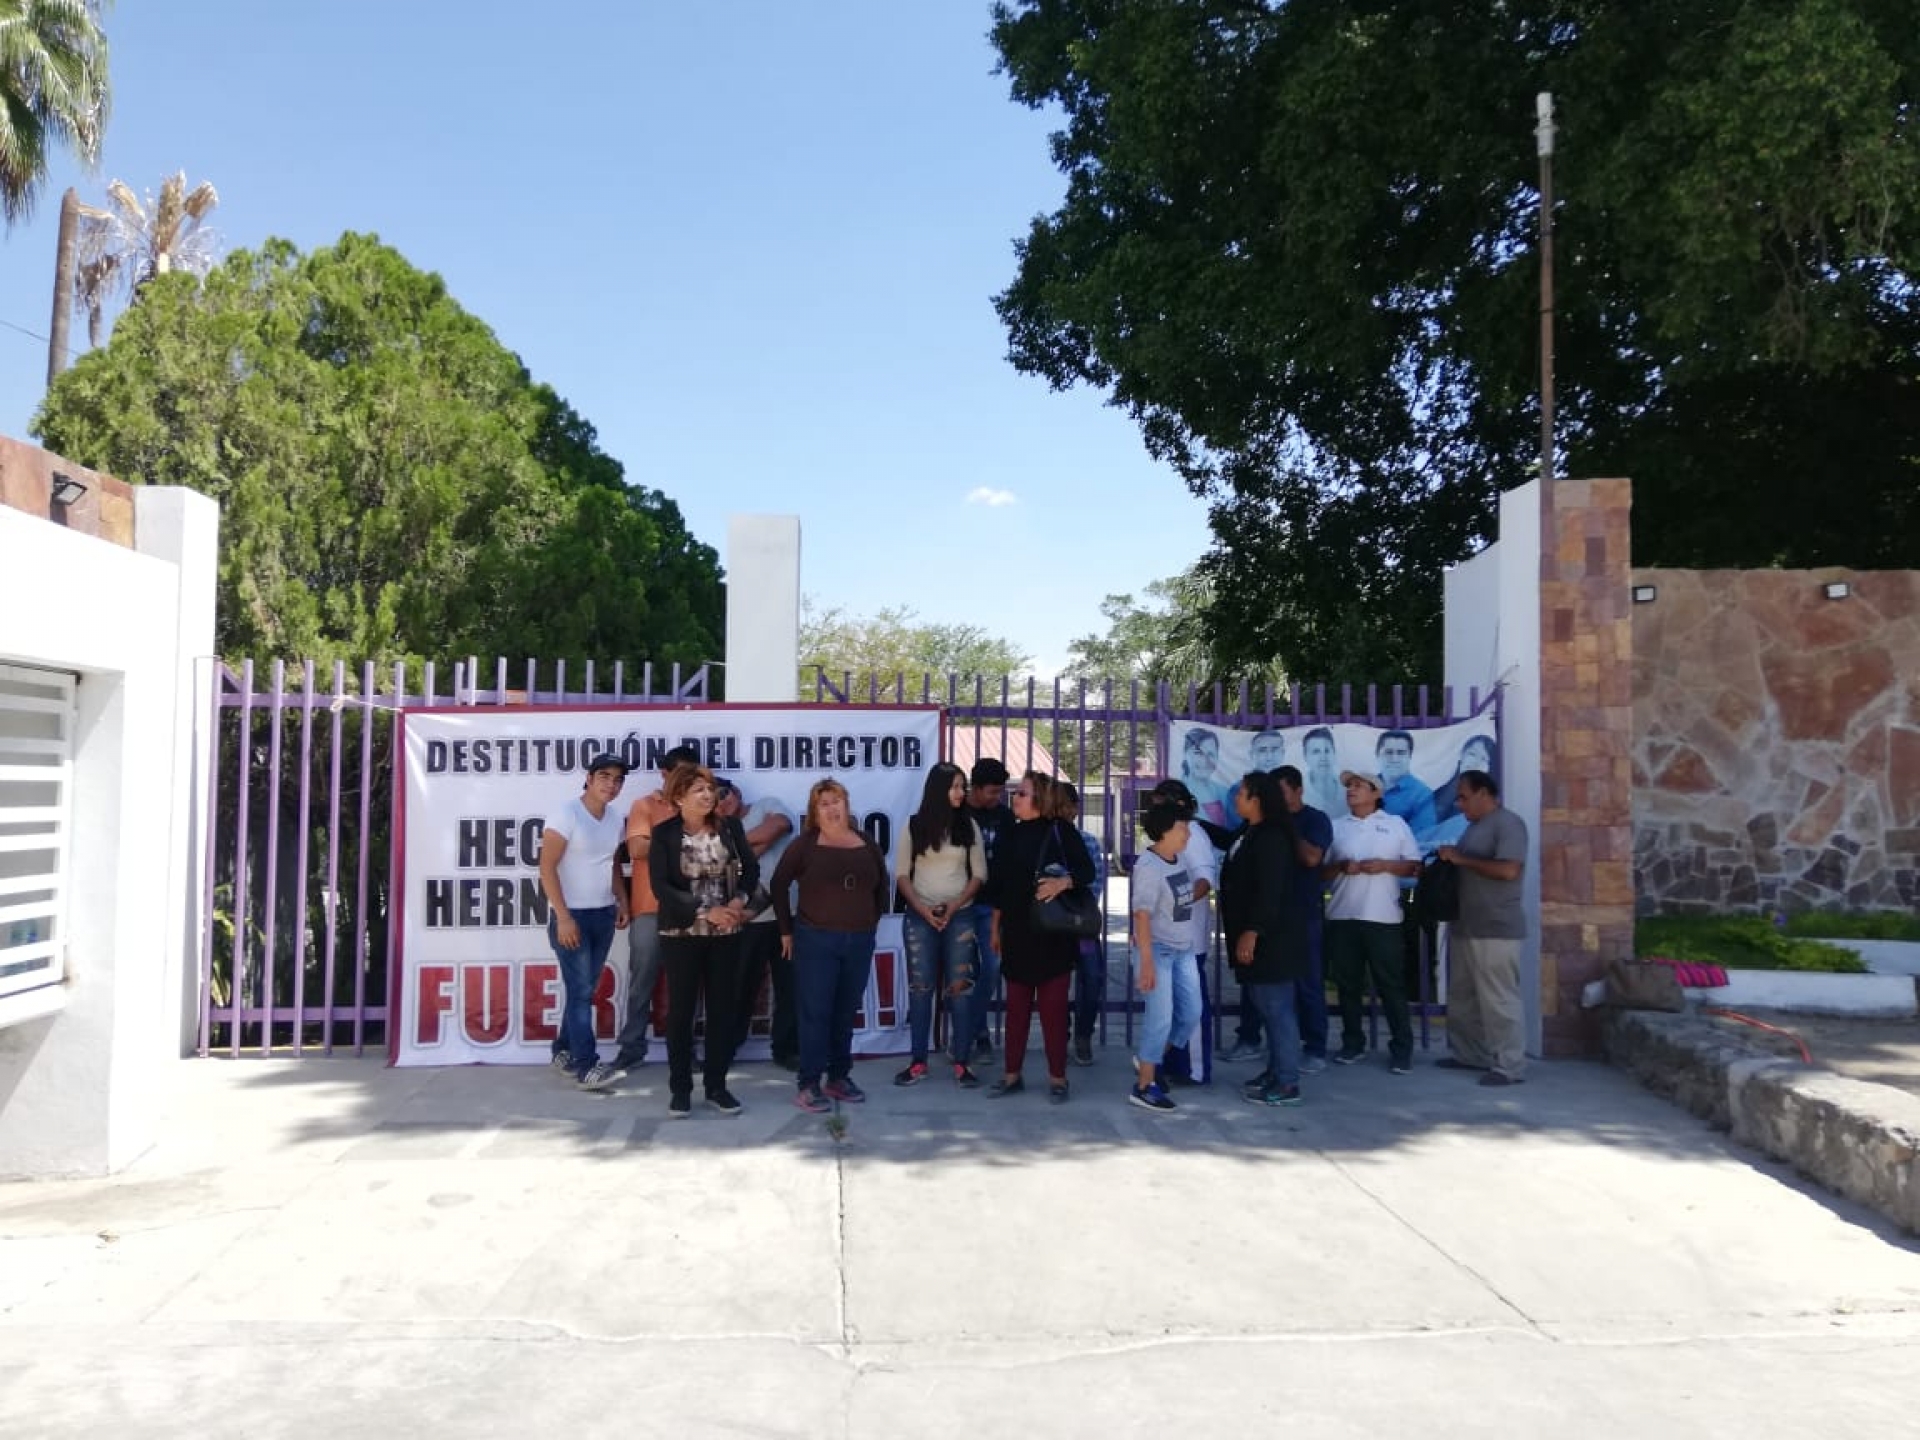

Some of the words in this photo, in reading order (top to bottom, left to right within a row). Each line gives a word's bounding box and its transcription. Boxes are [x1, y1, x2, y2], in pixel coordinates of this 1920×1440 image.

[754, 736, 921, 769] DIRECTOR
[459, 818, 546, 867] HEC
[426, 878, 549, 927] HERN
